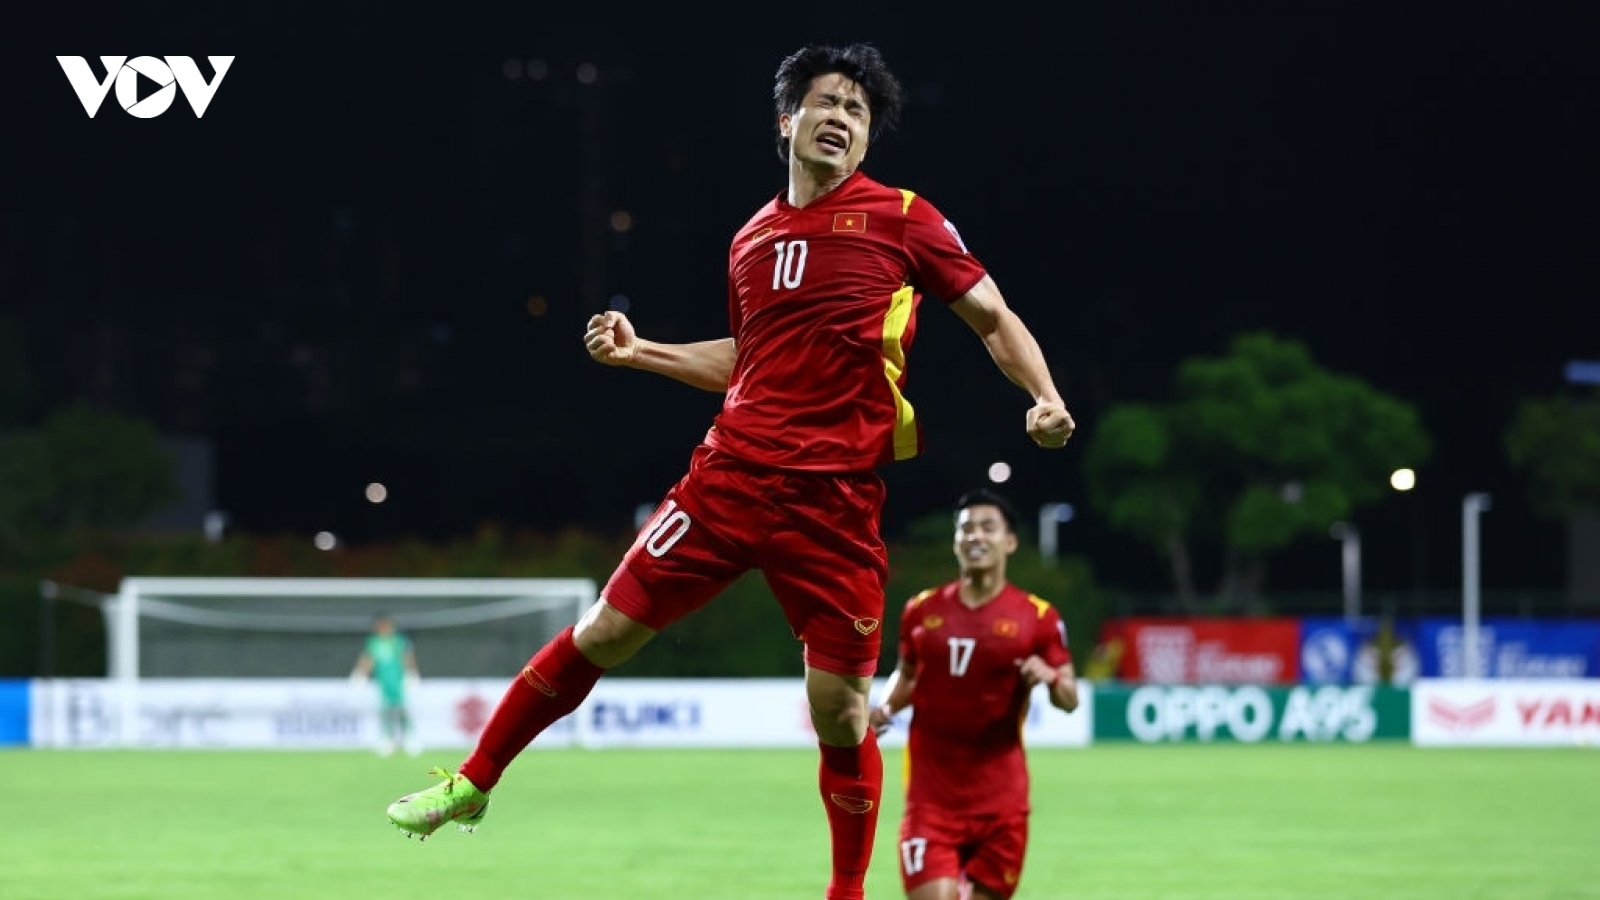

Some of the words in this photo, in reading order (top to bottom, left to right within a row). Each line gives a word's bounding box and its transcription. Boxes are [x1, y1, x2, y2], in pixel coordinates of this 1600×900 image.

[772, 240, 807, 290] 10
[645, 500, 691, 557] 10
[947, 637, 976, 676] 17
[1126, 684, 1274, 742] OPPO
[1279, 684, 1377, 742] A95
[900, 837, 928, 875] 17
